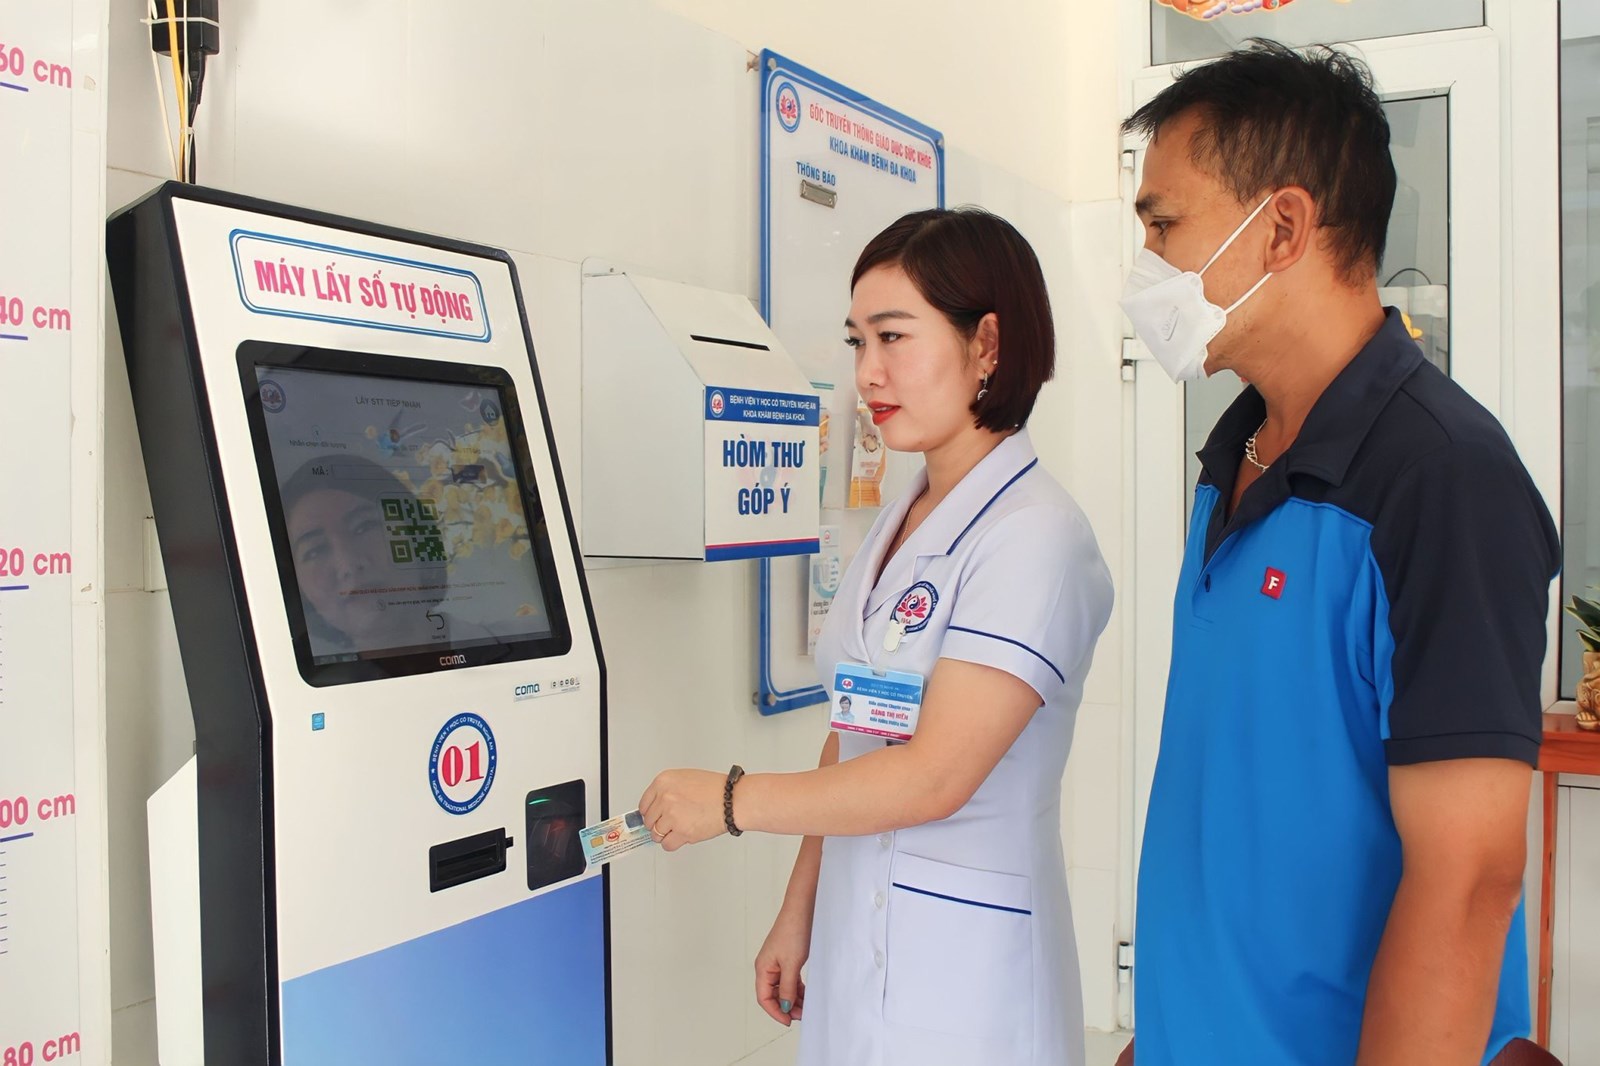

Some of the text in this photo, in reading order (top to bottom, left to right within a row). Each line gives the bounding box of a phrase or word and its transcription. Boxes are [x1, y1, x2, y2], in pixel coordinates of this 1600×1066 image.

[33, 60, 71, 88] cm
[810, 103, 824, 123] GÓC
[853, 123, 873, 144] THÔNG
[796, 161, 836, 186] THÔNG BÁO
[830, 136, 916, 184] KHOA KHÁM BỆNH ĐA KHOA
[254, 258, 474, 323] MÁY LẤY SỐ TỰ ĐỘNG
[33, 306, 71, 330] cm
[729, 395, 744, 405] BỆNH
[745, 396, 756, 407] VIỆN
[756, 398, 761, 406] Y
[760, 398, 771, 408] HỌC
[809, 402, 816, 410] AN
[743, 410, 805, 421] KHOA KHÁM BỆNH ĐA KHOA
[722, 434, 806, 468] HÒM THƯ
[738, 482, 791, 515] GÓP Ý
[33, 552, 72, 576] cm
[1268, 575, 1280, 590] F
[441, 740, 485, 787] 01
[38, 793, 75, 820] cm
[442, 799, 468, 812] TRADITIONAL
[3, 1032, 80, 1066] 80 cm
